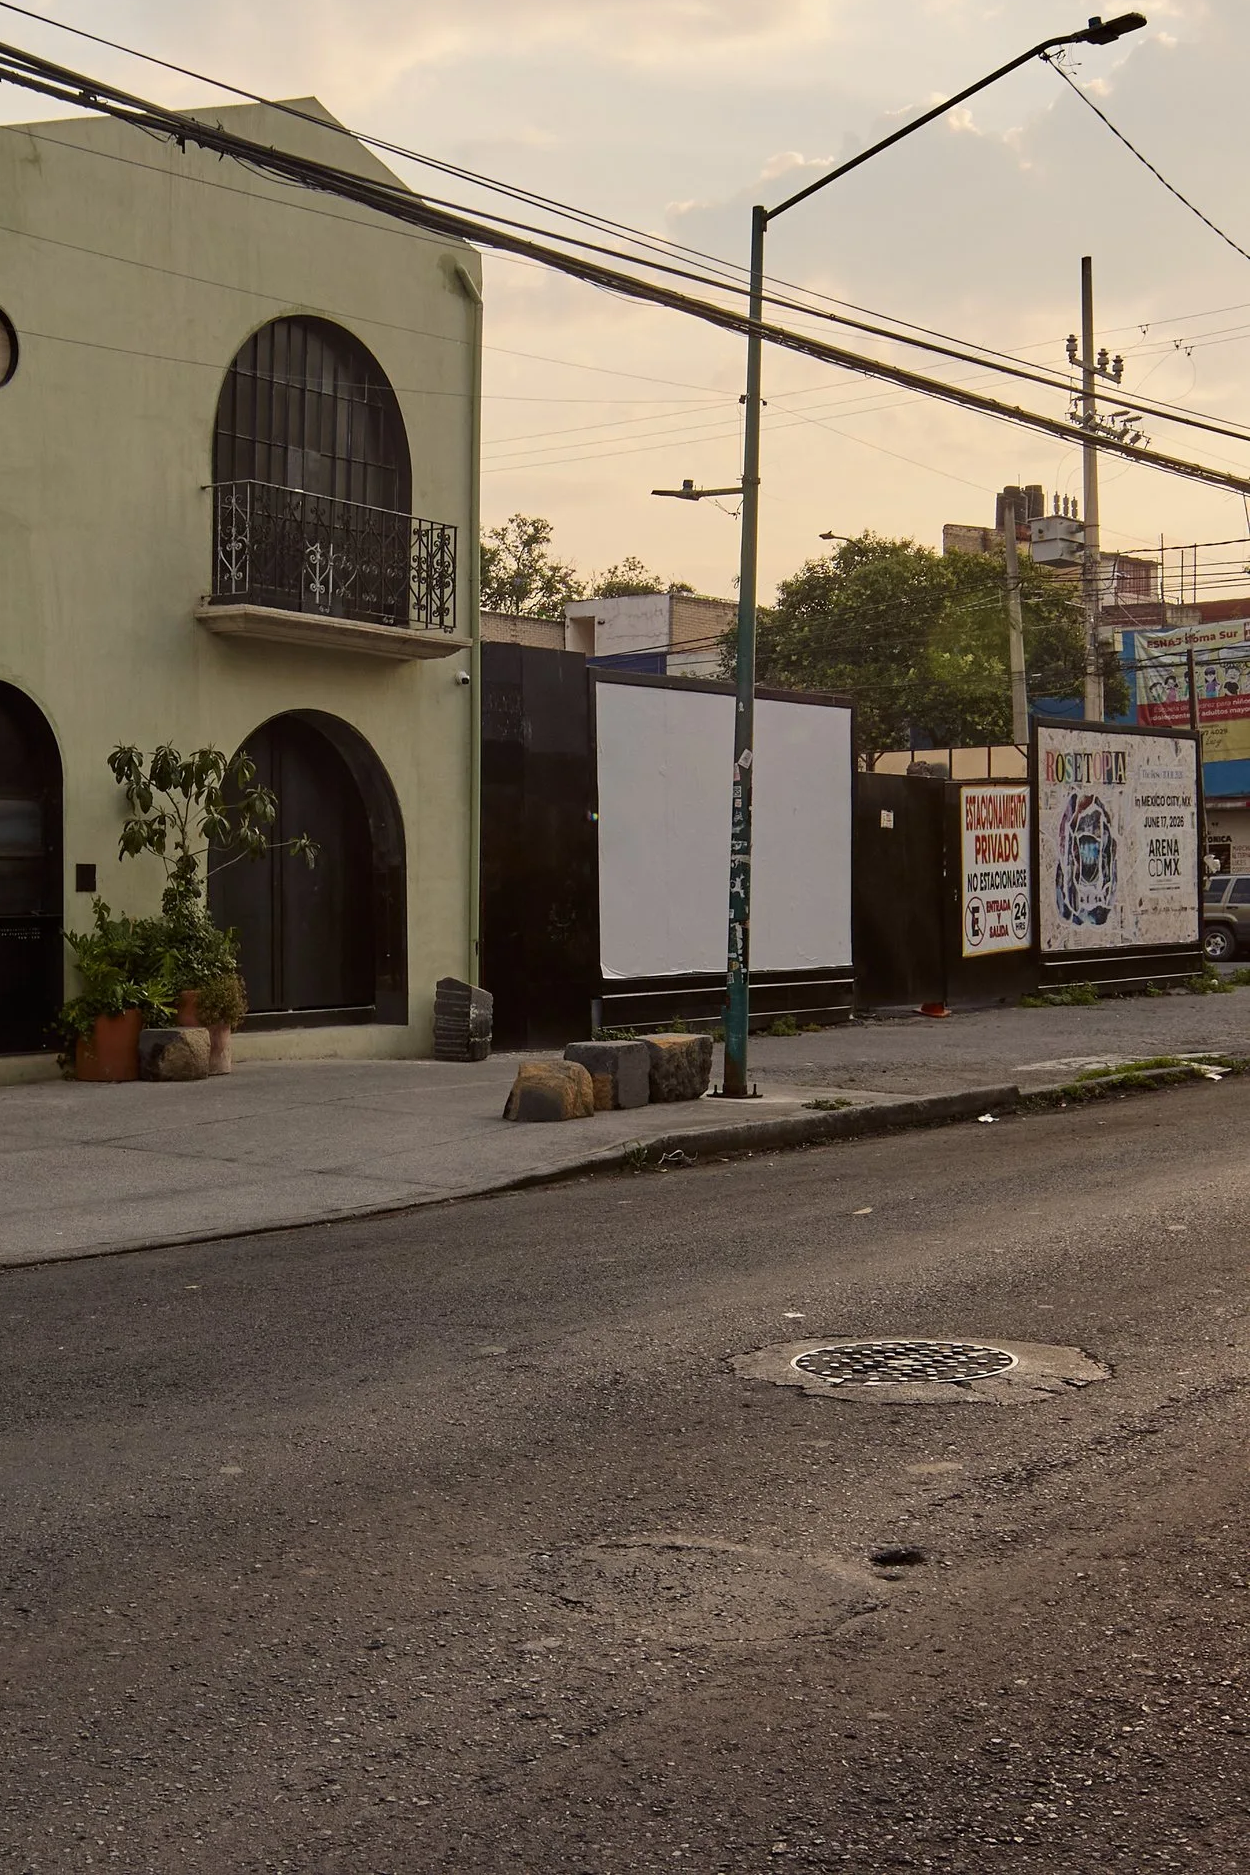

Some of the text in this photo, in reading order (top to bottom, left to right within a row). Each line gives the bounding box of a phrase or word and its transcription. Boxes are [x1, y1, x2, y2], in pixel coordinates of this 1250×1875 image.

[1220, 630, 1238, 640] Sur
[1201, 708, 1228, 717] adultos
[1046, 751, 1126, 785] ROSETOPIA
[1141, 795, 1165, 807] MEXICO
[1182, 795, 1191, 807] MX
[966, 794, 1027, 831] ESTACIONAMIENTO
[1144, 815, 1184, 829] JUNE 17, 2026
[975, 833, 1019, 865] PRIVADO
[1149, 839, 1179, 857] ARENA
[1148, 858, 1180, 877] CDMX
[967, 869, 1027, 893] NO ESTACIONARSE
[986, 899, 1011, 914] ENTRADA
[1014, 902, 1027, 921] 24
[997, 913, 1002, 924] Y
[1015, 921, 1026, 931] HRS
[989, 926, 1009, 939] SALIDA
